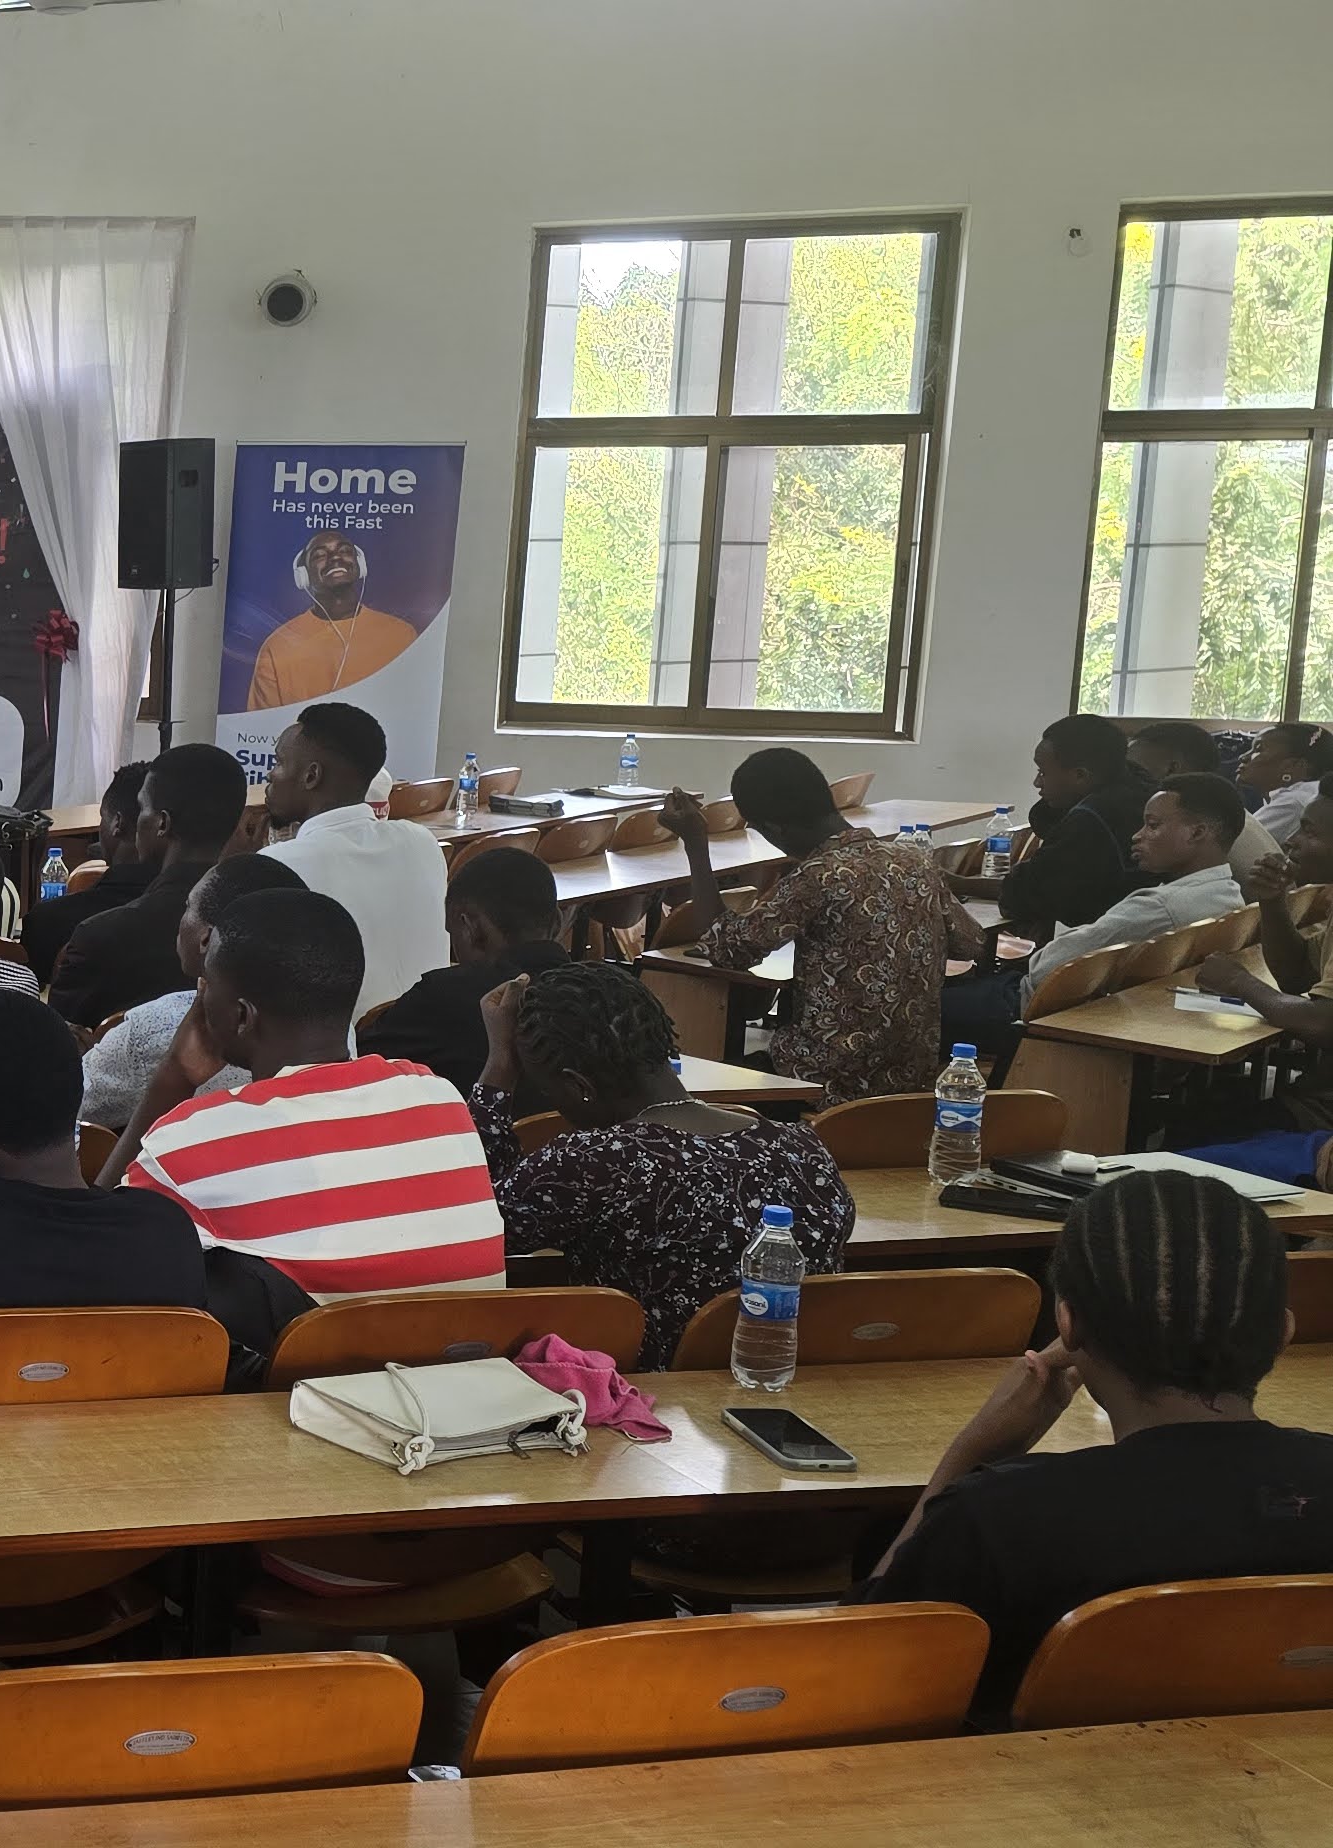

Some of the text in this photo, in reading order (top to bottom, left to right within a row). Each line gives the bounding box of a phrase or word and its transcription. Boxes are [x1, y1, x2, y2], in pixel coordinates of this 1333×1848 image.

[274, 461, 417, 494] Home
[273, 499, 414, 514] Has never been
[305, 514, 383, 529] this Fast
[237, 732, 269, 743] Now
